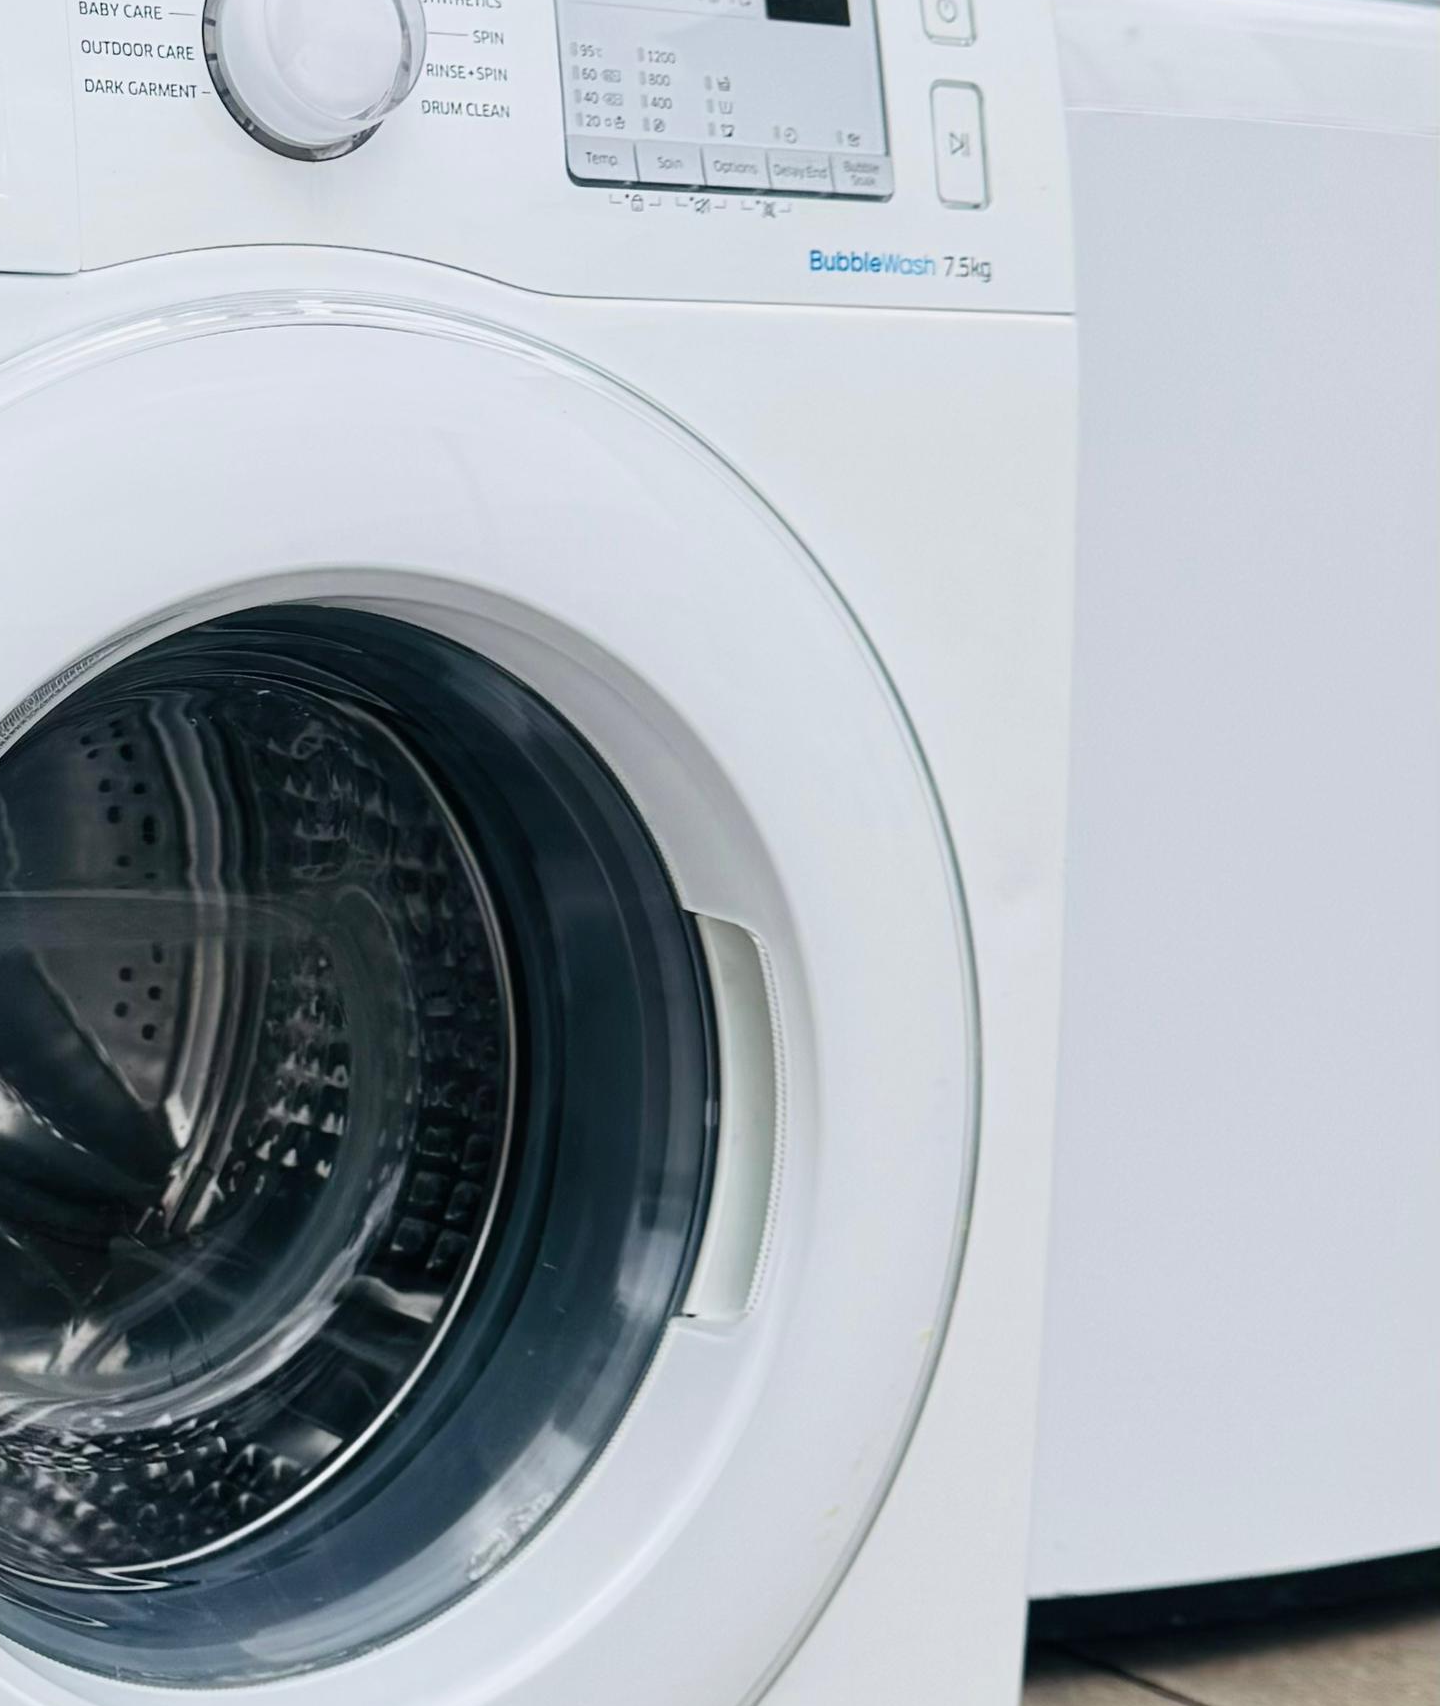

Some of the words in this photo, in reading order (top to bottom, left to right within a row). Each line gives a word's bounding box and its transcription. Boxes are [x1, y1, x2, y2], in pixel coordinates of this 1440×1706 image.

[78, 1, 119, 17] BABY
[123, 4, 163, 20] CARE
[472, 30, 504, 45] SPIN
[81, 39, 153, 57] OUTDOOR
[157, 44, 196, 60] CARE
[84, 78, 123, 94] DARK
[128, 81, 197, 98] GARMENT
[421, 100, 462, 116] DRUM
[465, 102, 510, 118] CLEAN
[809, 249, 936, 276] BubbleWash
